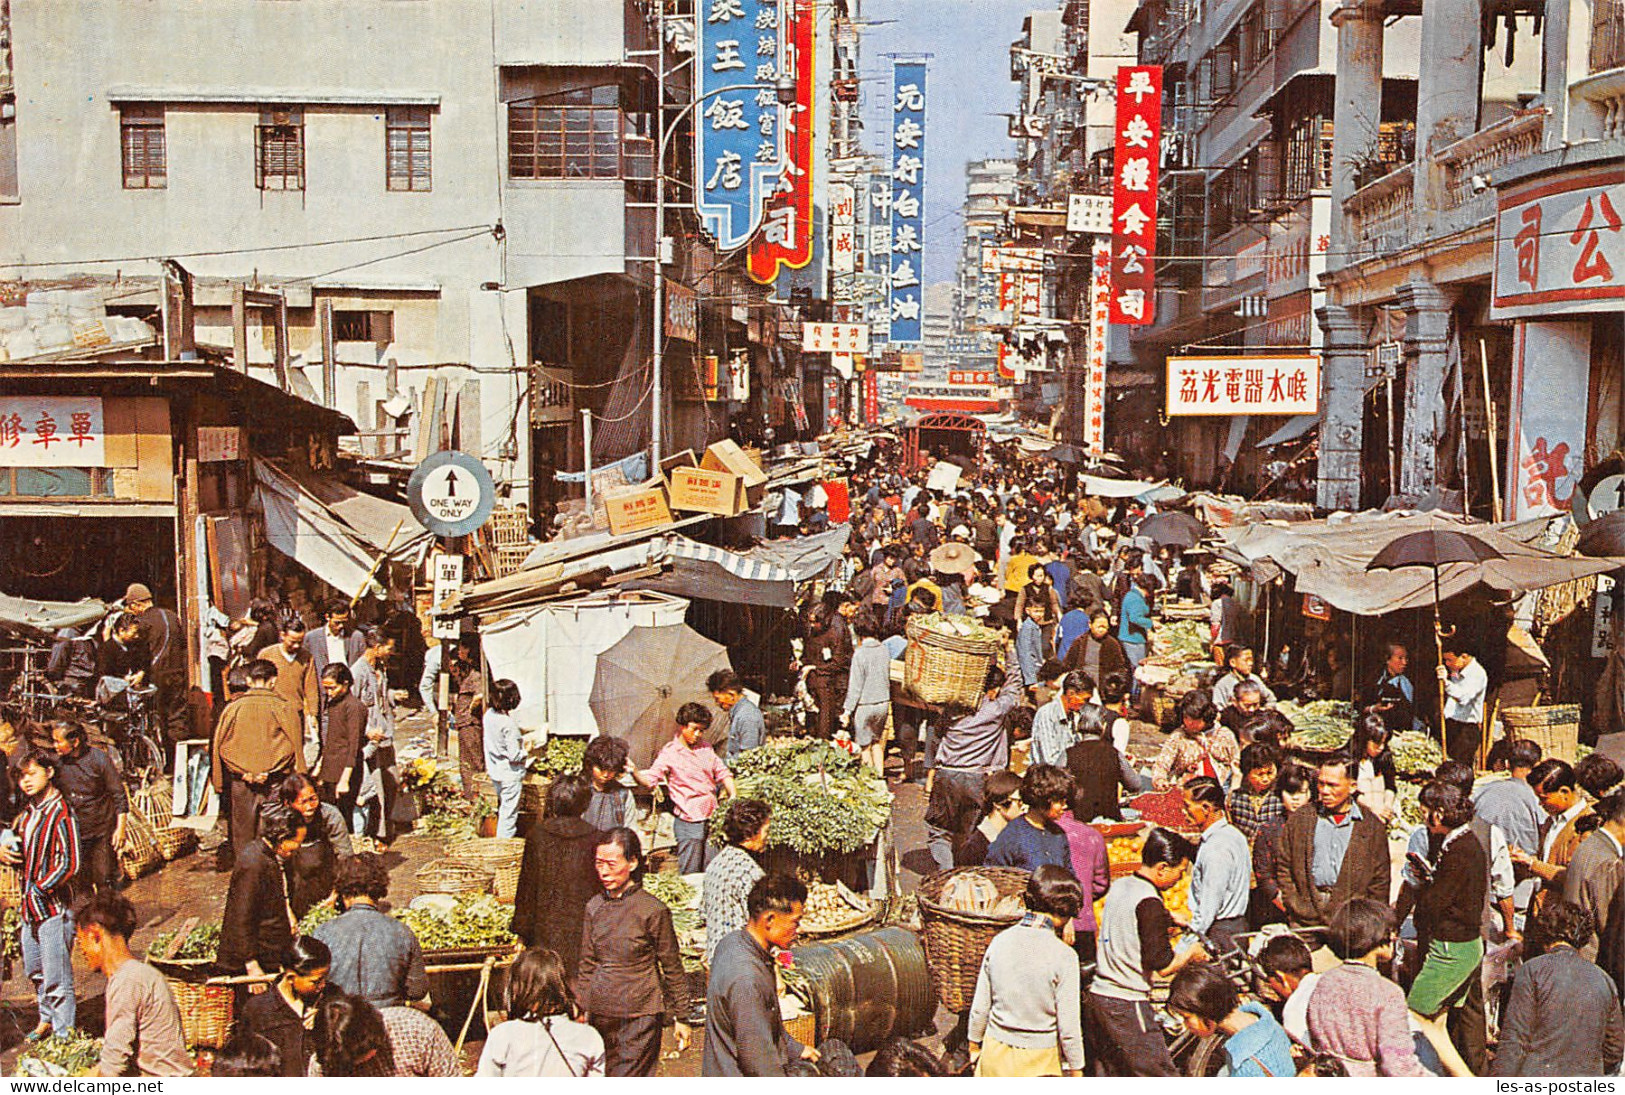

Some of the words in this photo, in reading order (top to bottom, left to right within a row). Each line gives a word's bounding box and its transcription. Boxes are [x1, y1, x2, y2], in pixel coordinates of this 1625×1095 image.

[891, 83, 925, 321] 元安行白米生油
[1117, 71, 1156, 320] 平安糧食公司
[1179, 368, 1308, 403] 荔光電器水喉
[1522, 437, 1577, 511] 記
[430, 498, 449, 508] ONE
[453, 498, 473, 508] WAY
[440, 509, 463, 517] ONLY
